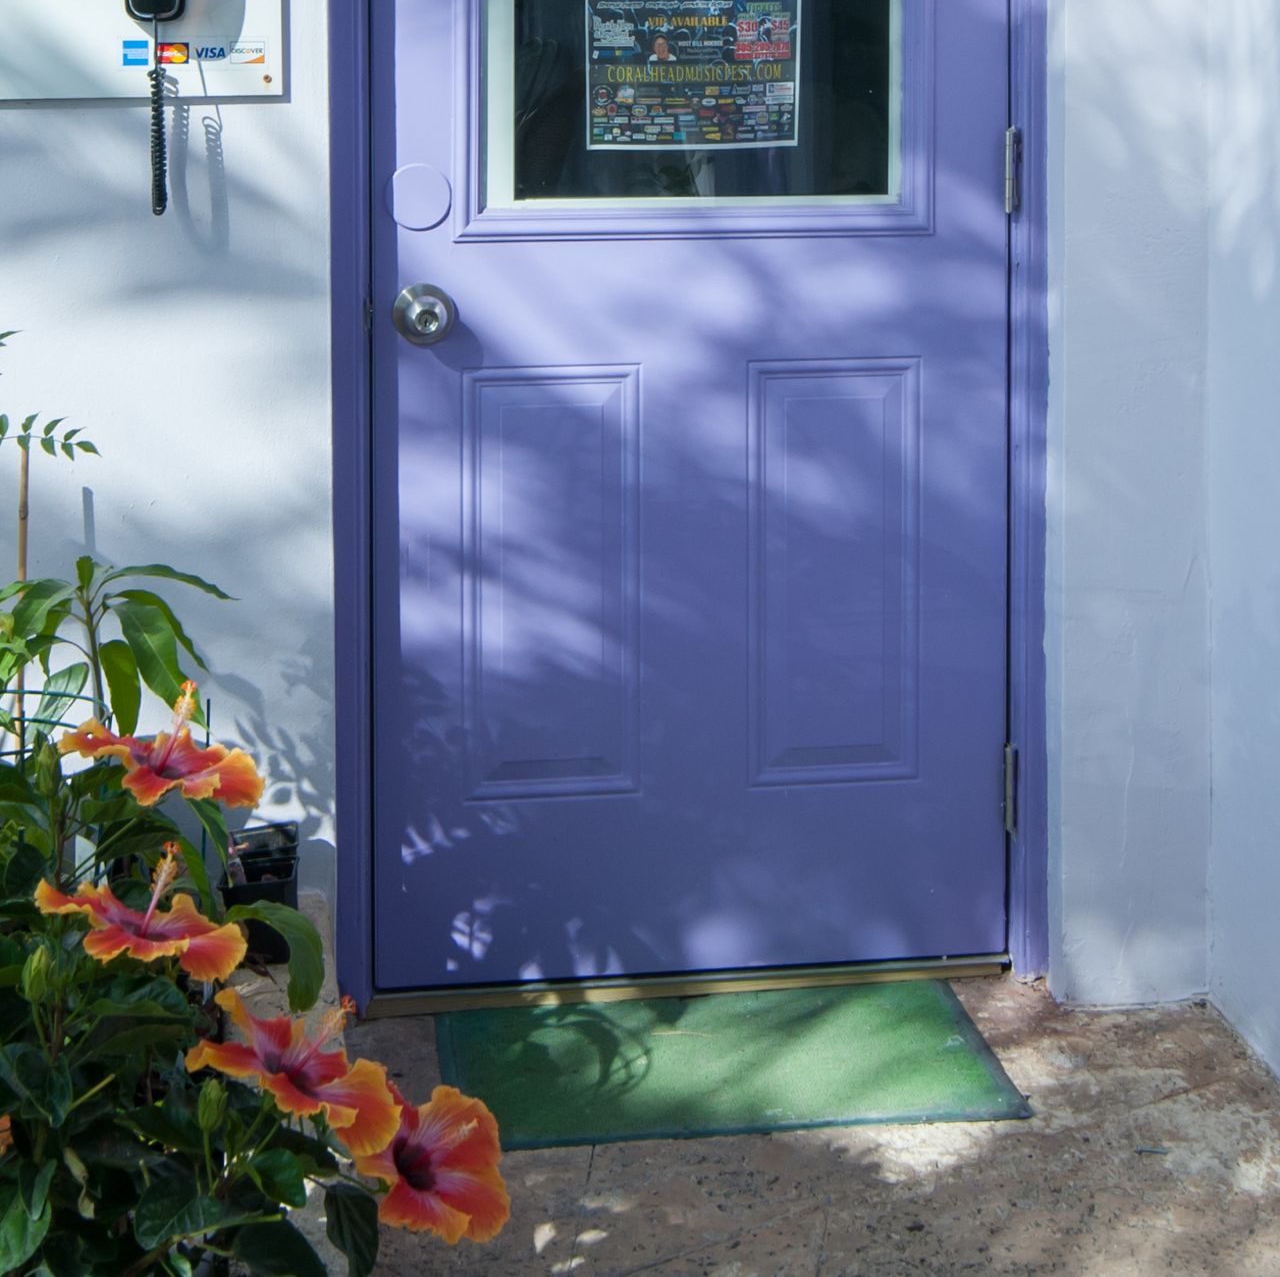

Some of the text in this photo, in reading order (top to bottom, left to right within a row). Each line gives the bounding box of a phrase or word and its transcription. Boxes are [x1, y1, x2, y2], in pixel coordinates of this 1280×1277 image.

[648, 16, 667, 27] VIP
[671, 16, 728, 27] AVAILABLE
[195, 47, 226, 59] VISA
